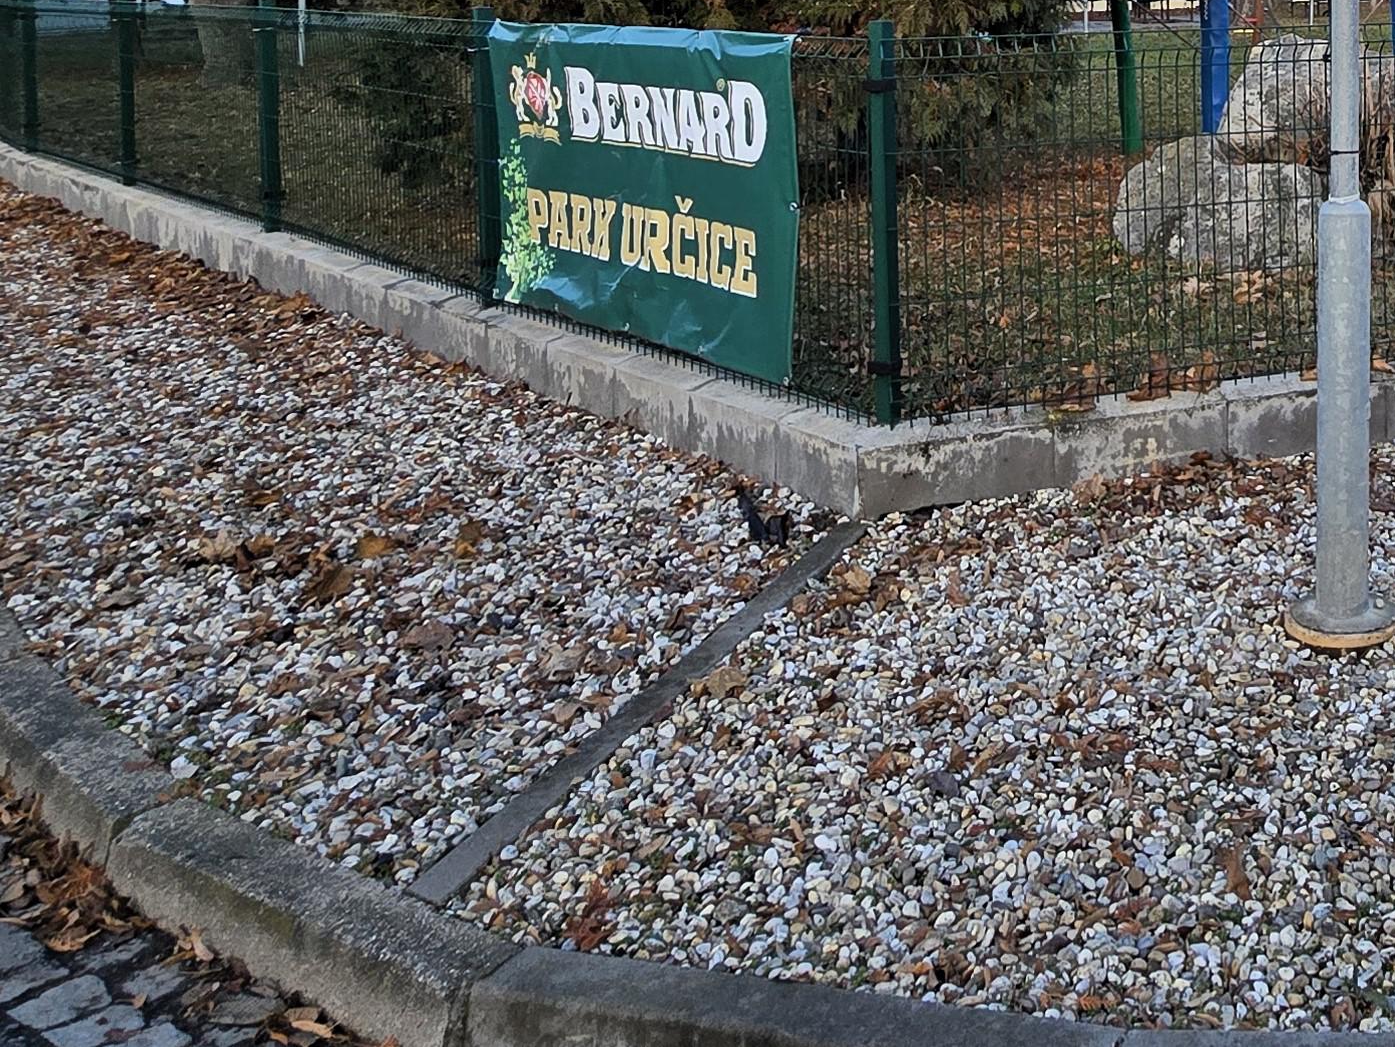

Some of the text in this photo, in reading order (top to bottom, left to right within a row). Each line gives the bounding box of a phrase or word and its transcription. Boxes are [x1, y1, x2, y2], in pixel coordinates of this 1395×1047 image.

[564, 66, 768, 167] BERNARD
[526, 187, 758, 299] PARK URČICE
